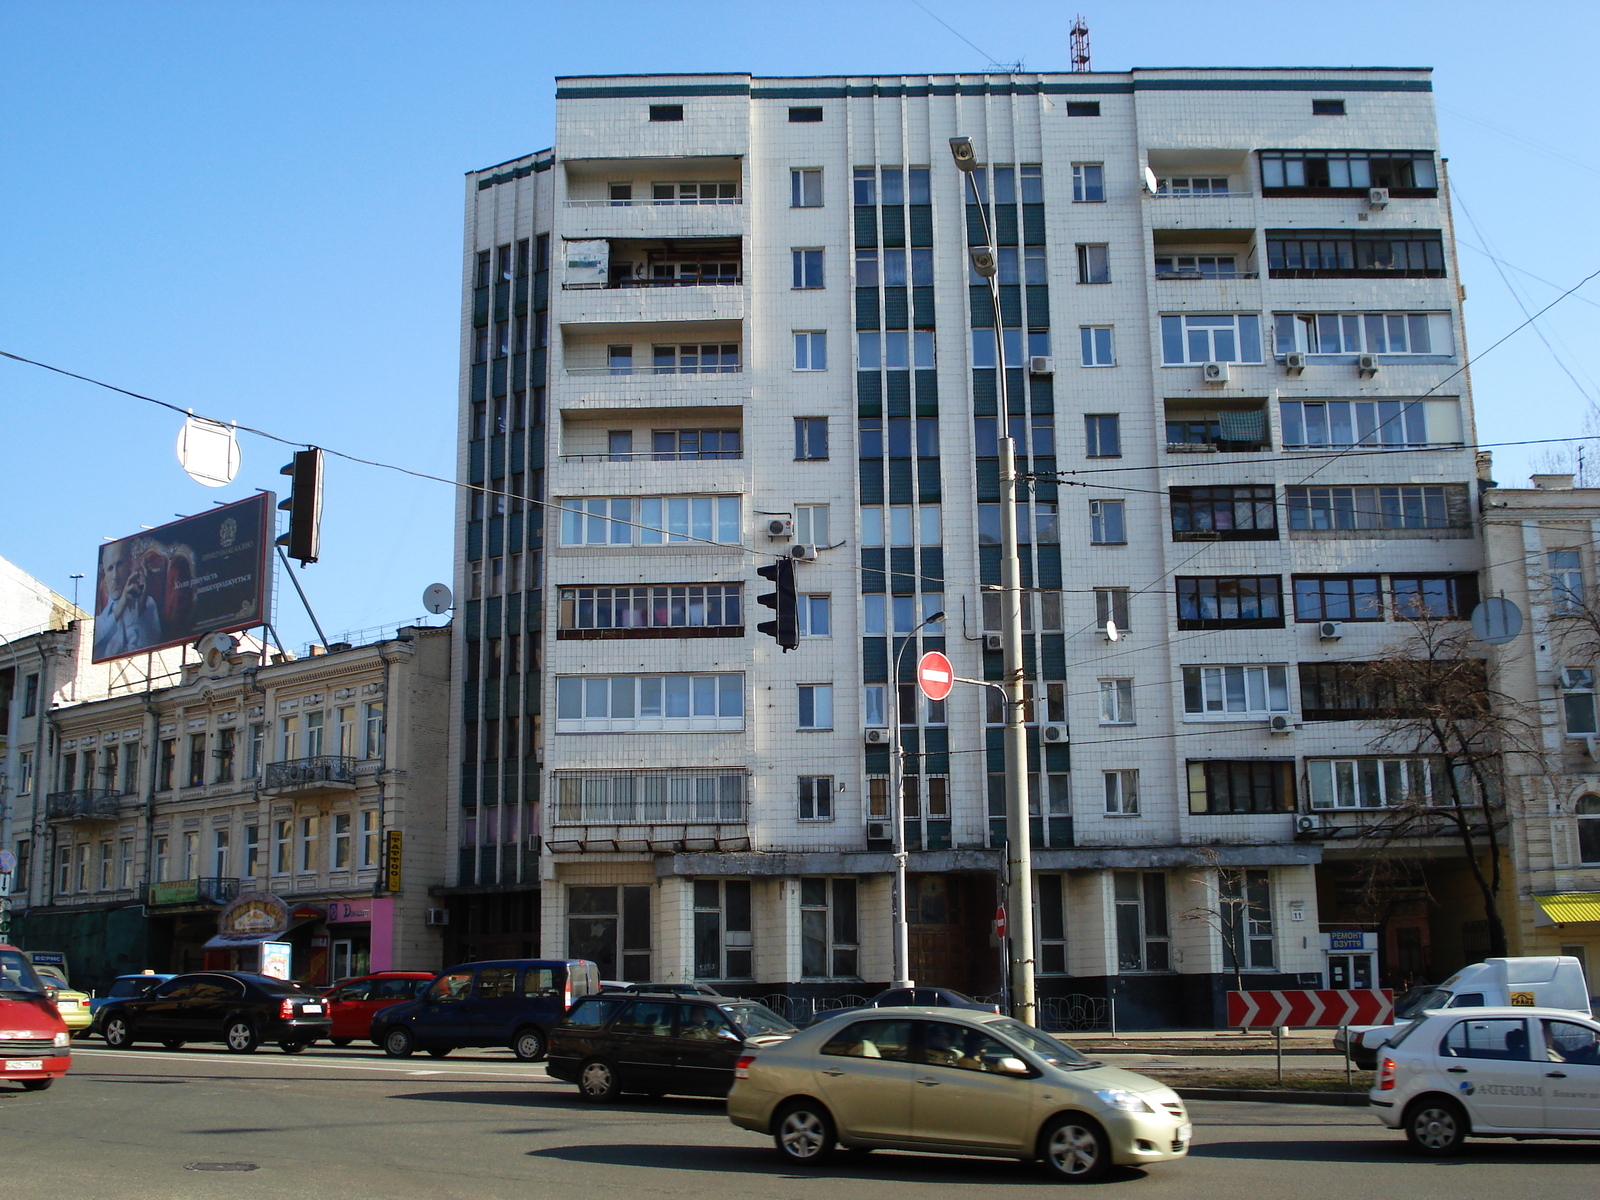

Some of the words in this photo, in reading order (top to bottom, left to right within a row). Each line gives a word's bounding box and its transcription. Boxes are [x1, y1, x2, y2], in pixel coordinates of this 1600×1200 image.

[391, 837, 400, 877] TATTOO
[1331, 932, 1362, 940] РЕМОНТ
[1477, 1084, 1544, 1097] ARTERIUM
